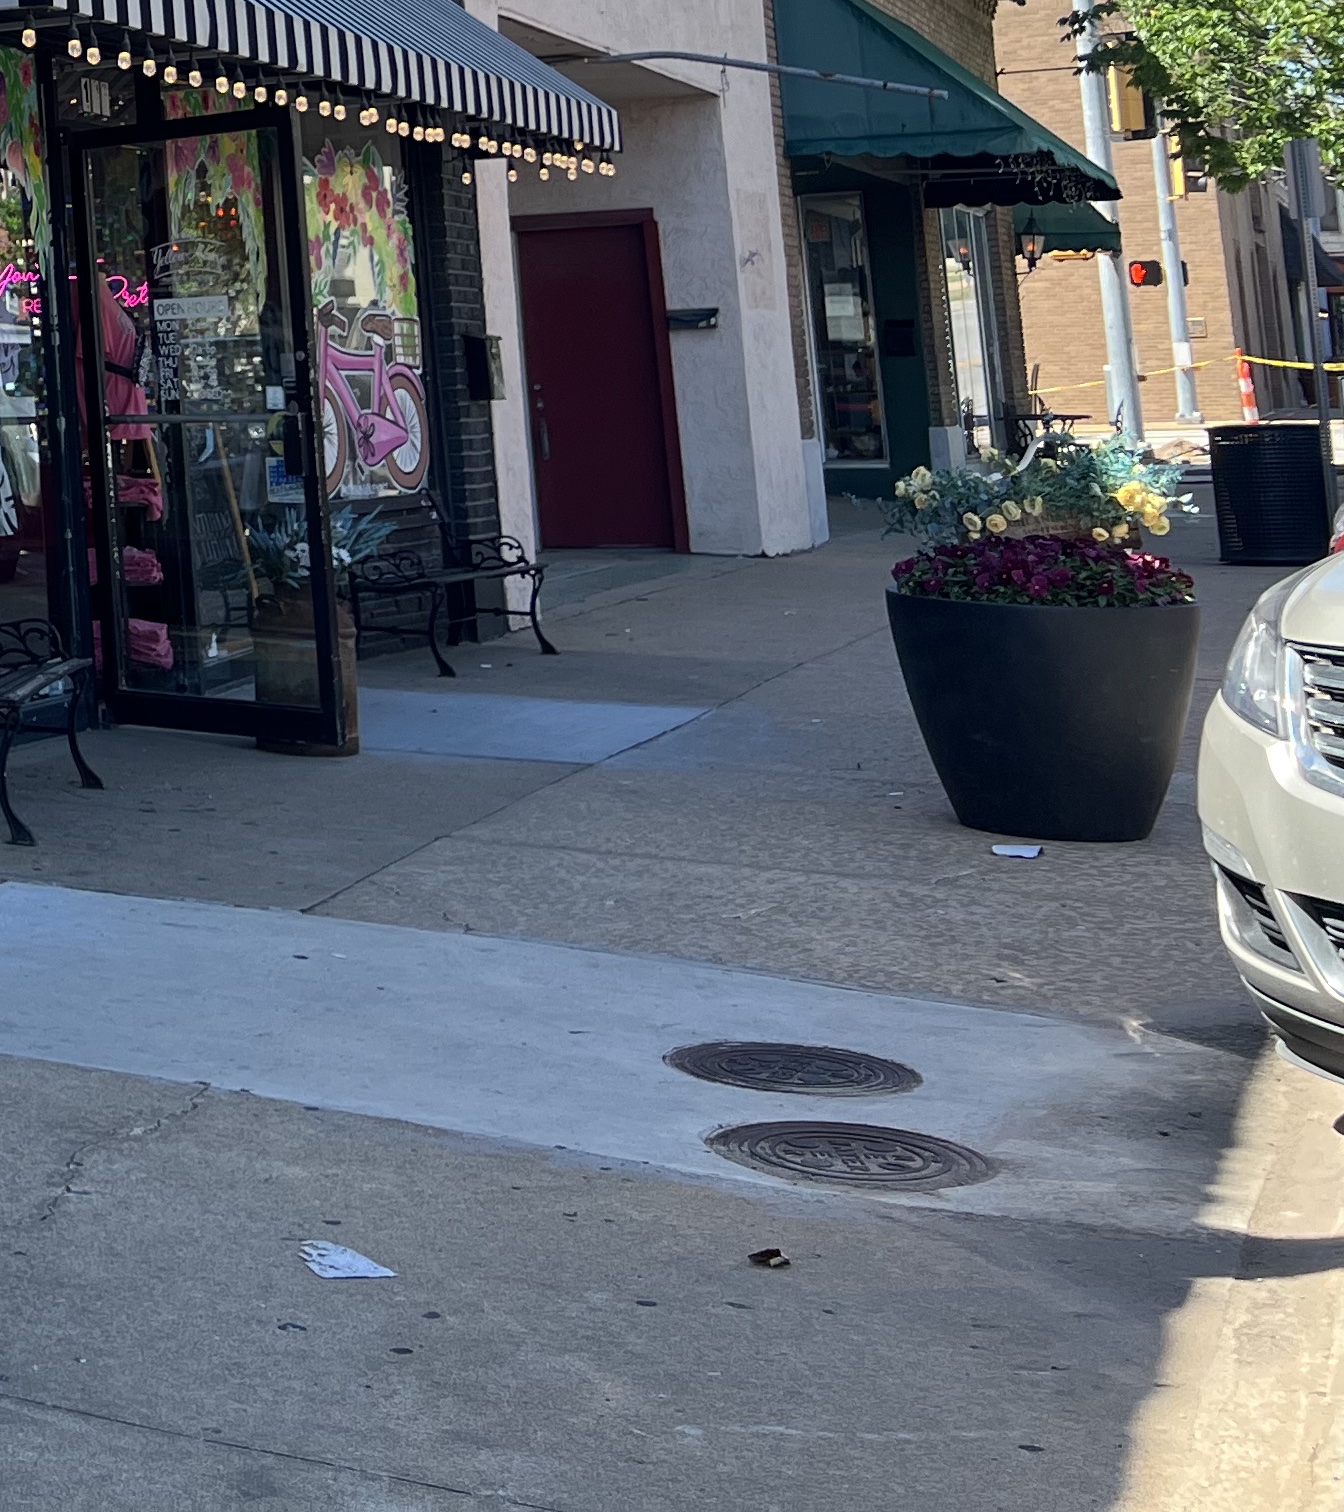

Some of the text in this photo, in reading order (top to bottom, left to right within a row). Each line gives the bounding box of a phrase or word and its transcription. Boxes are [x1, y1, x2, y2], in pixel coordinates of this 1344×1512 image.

[156, 302, 185, 317] OPEN
[156, 320, 180, 332] MON
[158, 332, 177, 343] TUE
[158, 344, 182, 356] WED
[158, 356, 178, 368] THU
[160, 368, 174, 379] FRI
[160, 378, 179, 389] SAT
[160, 390, 181, 400] SUN
